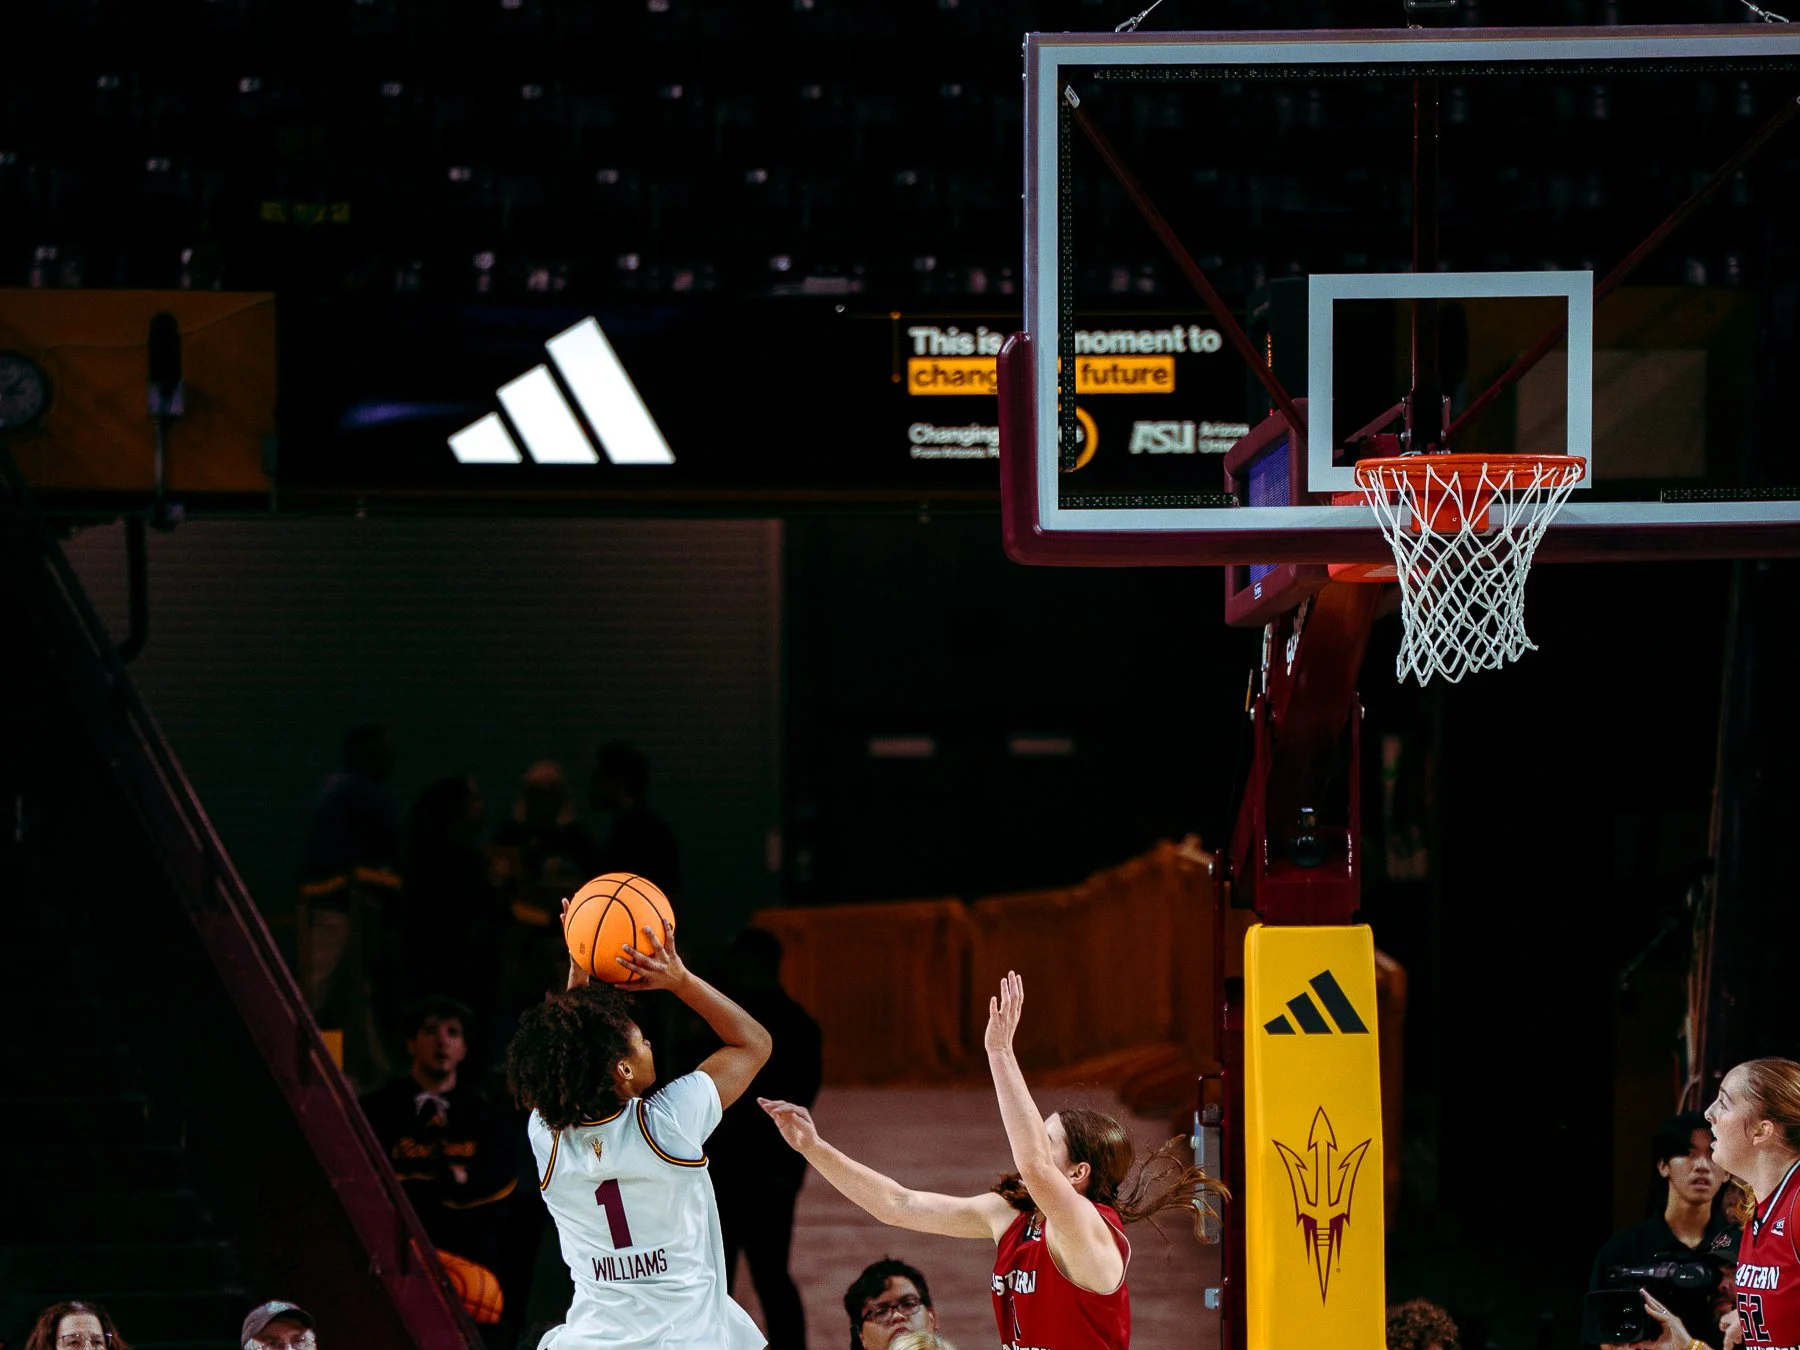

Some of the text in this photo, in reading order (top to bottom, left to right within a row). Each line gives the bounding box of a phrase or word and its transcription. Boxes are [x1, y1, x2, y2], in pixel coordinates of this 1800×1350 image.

[908, 326, 976, 356] This
[976, 326, 1004, 356] is
[1187, 325, 1223, 354] to
[1081, 362, 1169, 386] future
[1129, 420, 1197, 454] ASU
[595, 1178, 633, 1250] 1
[592, 1248, 668, 1282] WILLIAMS
[1735, 1263, 1780, 1290] ASTERN
[1736, 1292, 1772, 1343] 52
